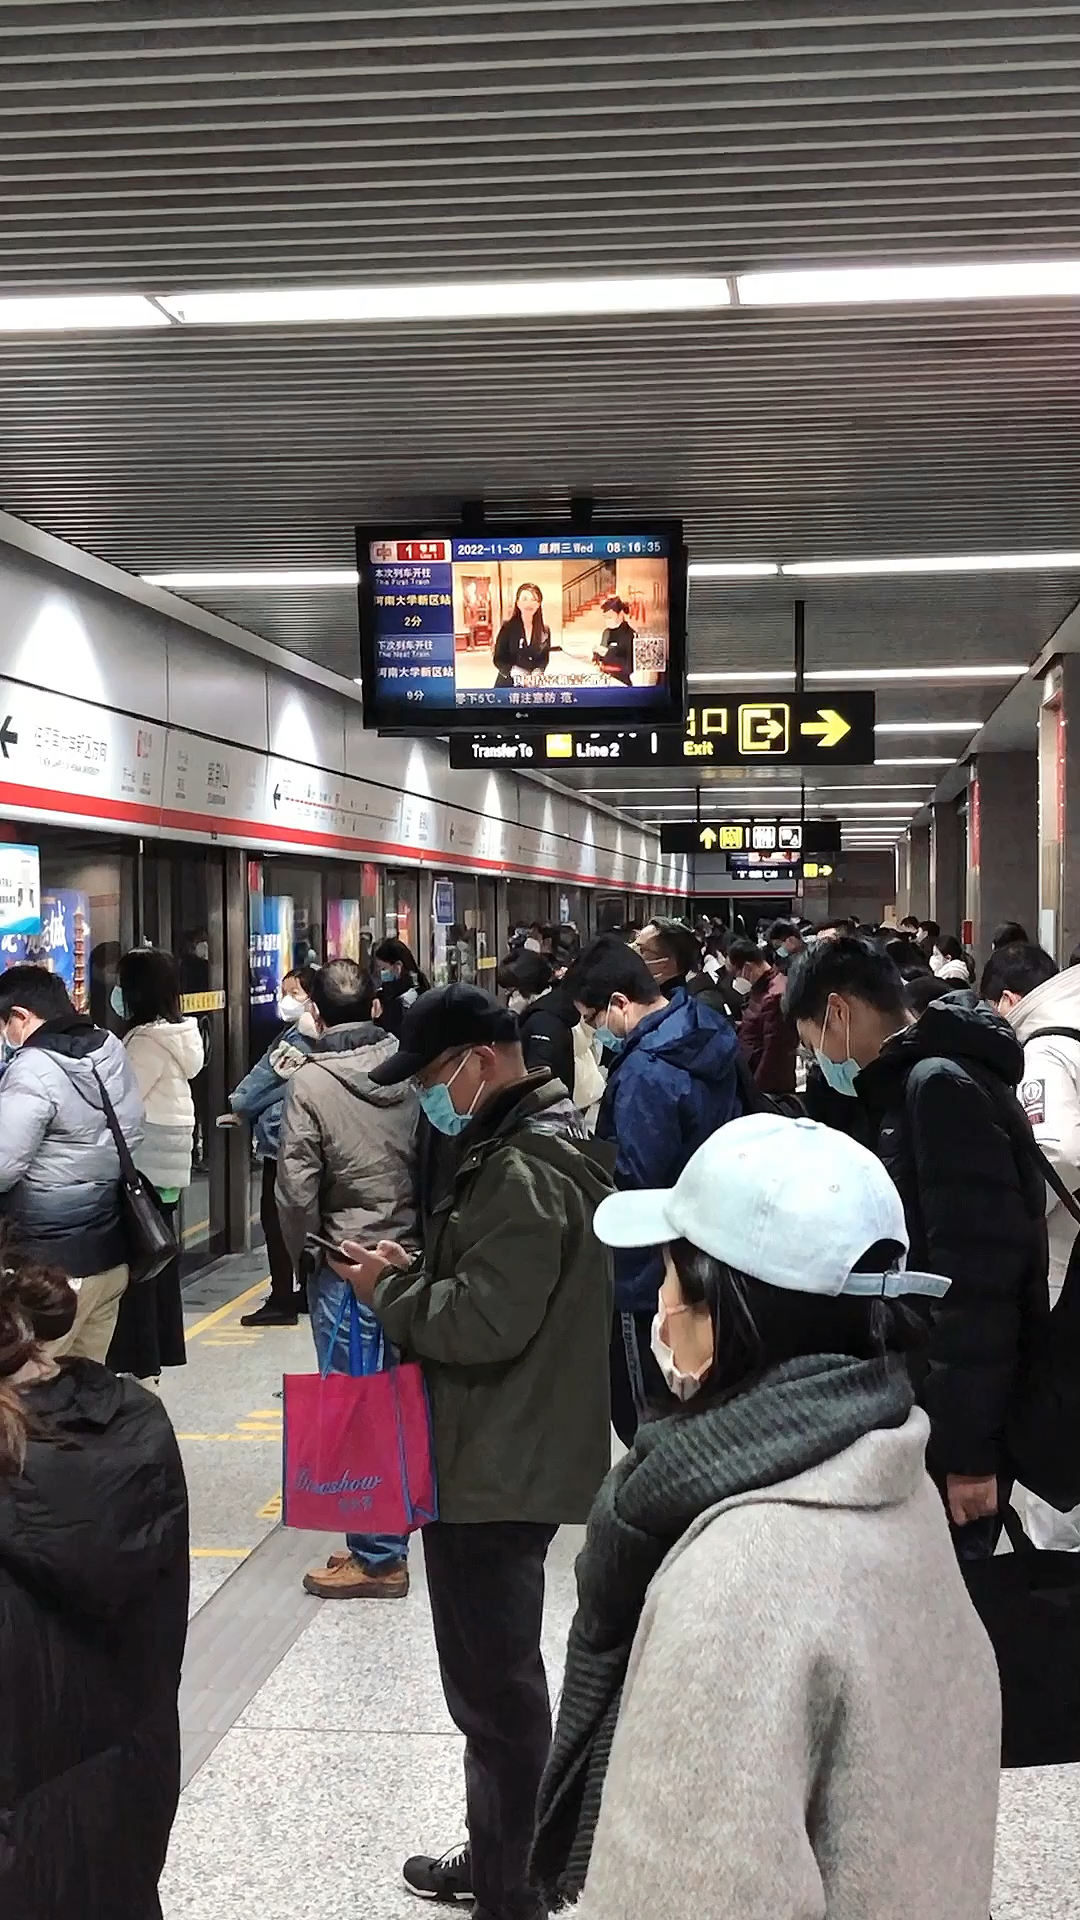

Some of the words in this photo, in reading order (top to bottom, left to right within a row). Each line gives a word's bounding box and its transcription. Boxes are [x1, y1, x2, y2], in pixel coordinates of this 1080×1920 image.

[458, 543, 523, 556] 2022-11-30
[606, 541, 661, 553] 08:16:35
[374, 567, 432, 578] 本次列车开往
[373, 594, 452, 607] 河南大学新区站
[403, 615, 423, 627] 2分
[377, 640, 433, 651] 下次列车开往
[376, 665, 454, 678] 河南大学新区站
[406, 688, 425, 701] 9分
[471, 743, 518, 758] Transfer
[683, 741, 714, 756] Exit
